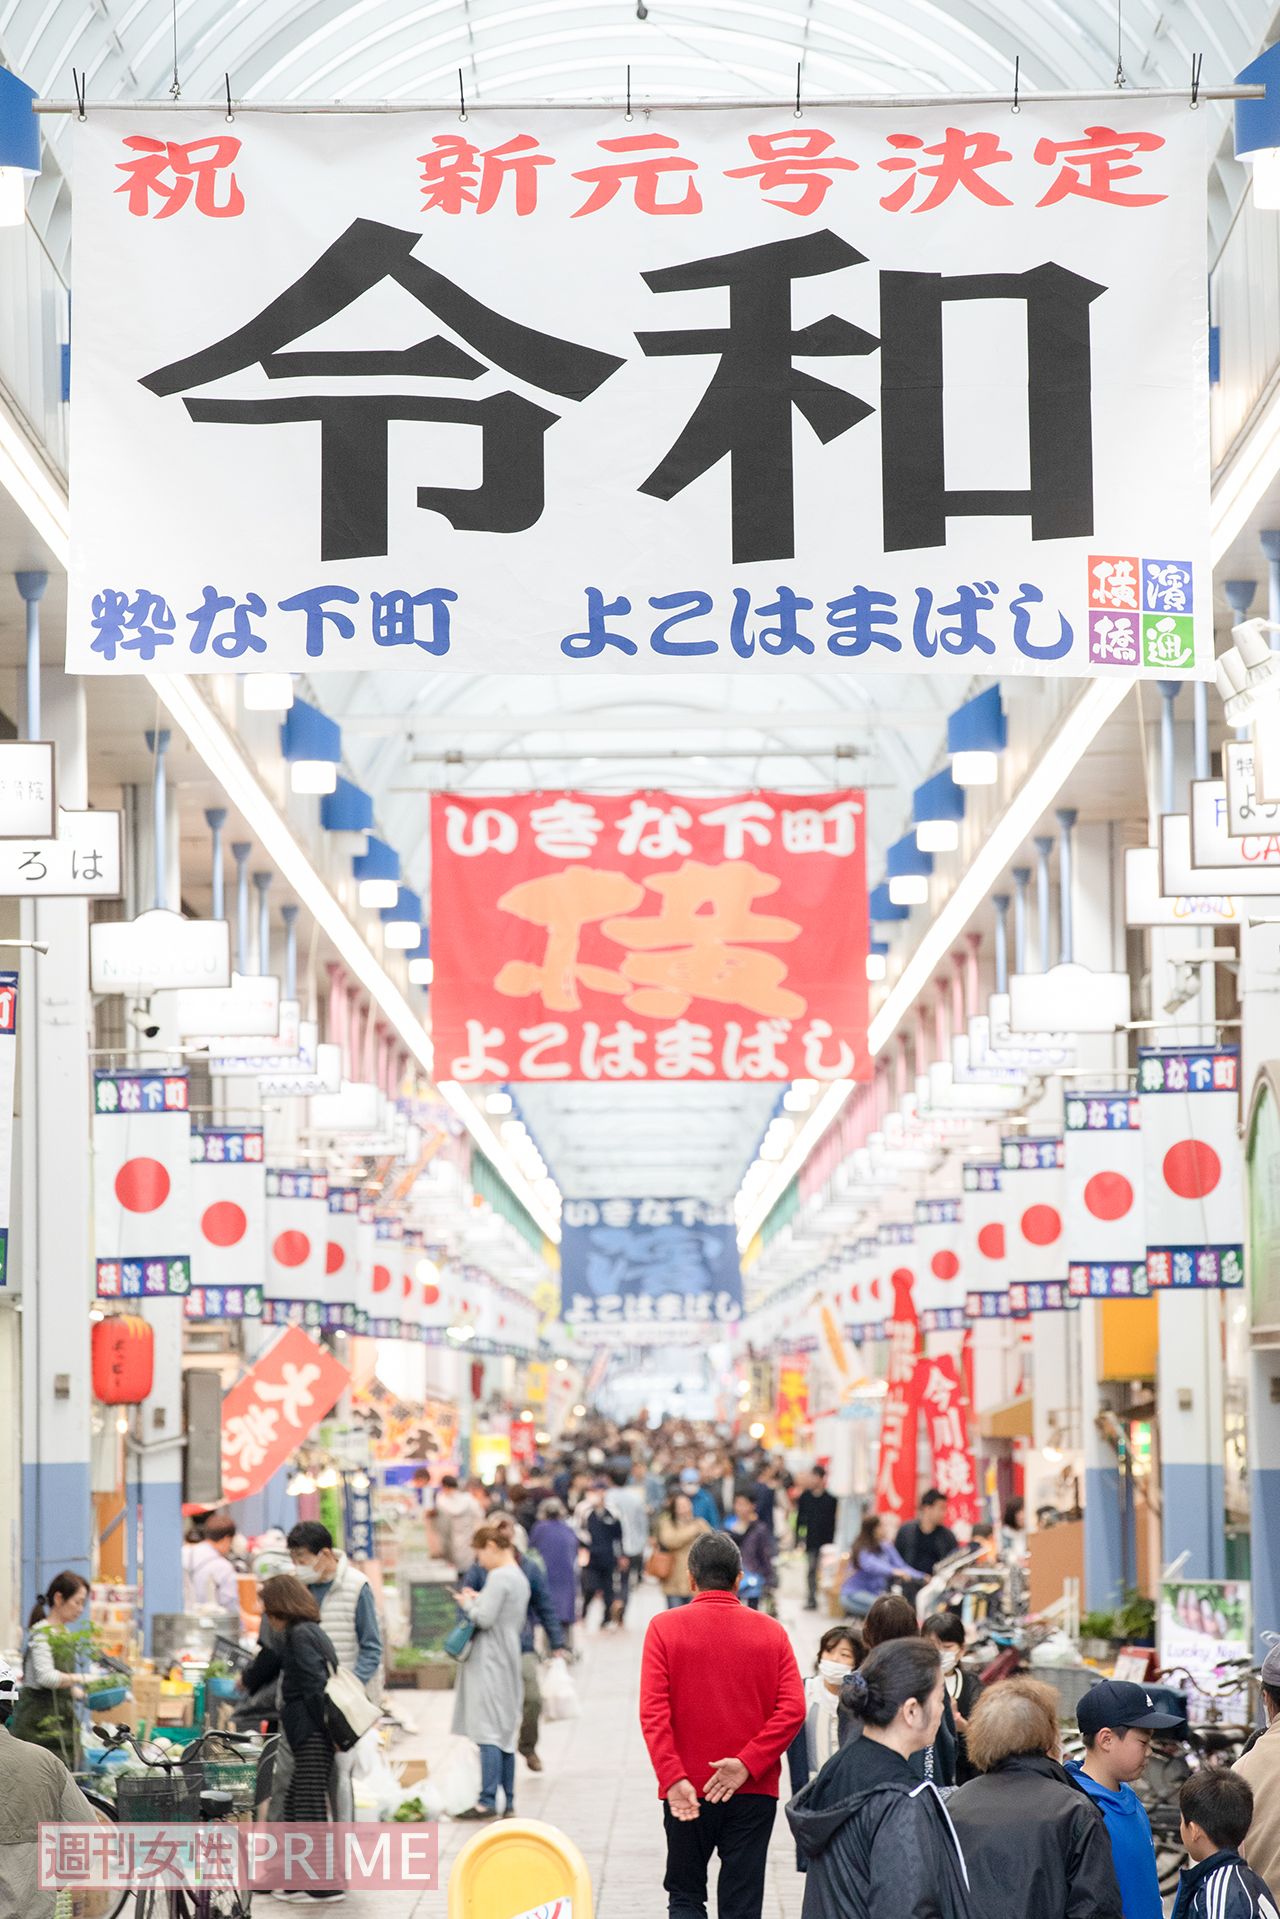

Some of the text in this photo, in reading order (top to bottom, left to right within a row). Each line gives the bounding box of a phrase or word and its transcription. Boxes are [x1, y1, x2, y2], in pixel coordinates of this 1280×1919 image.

[115, 126, 1168, 219] 祝 新元号決定
[138, 218, 1108, 564] 令和
[91, 581, 1074, 660] 粋な下町 よこはまばし
[446, 800, 863, 860] いきな下町
[450, 1018, 855, 1080] よこはまばし
